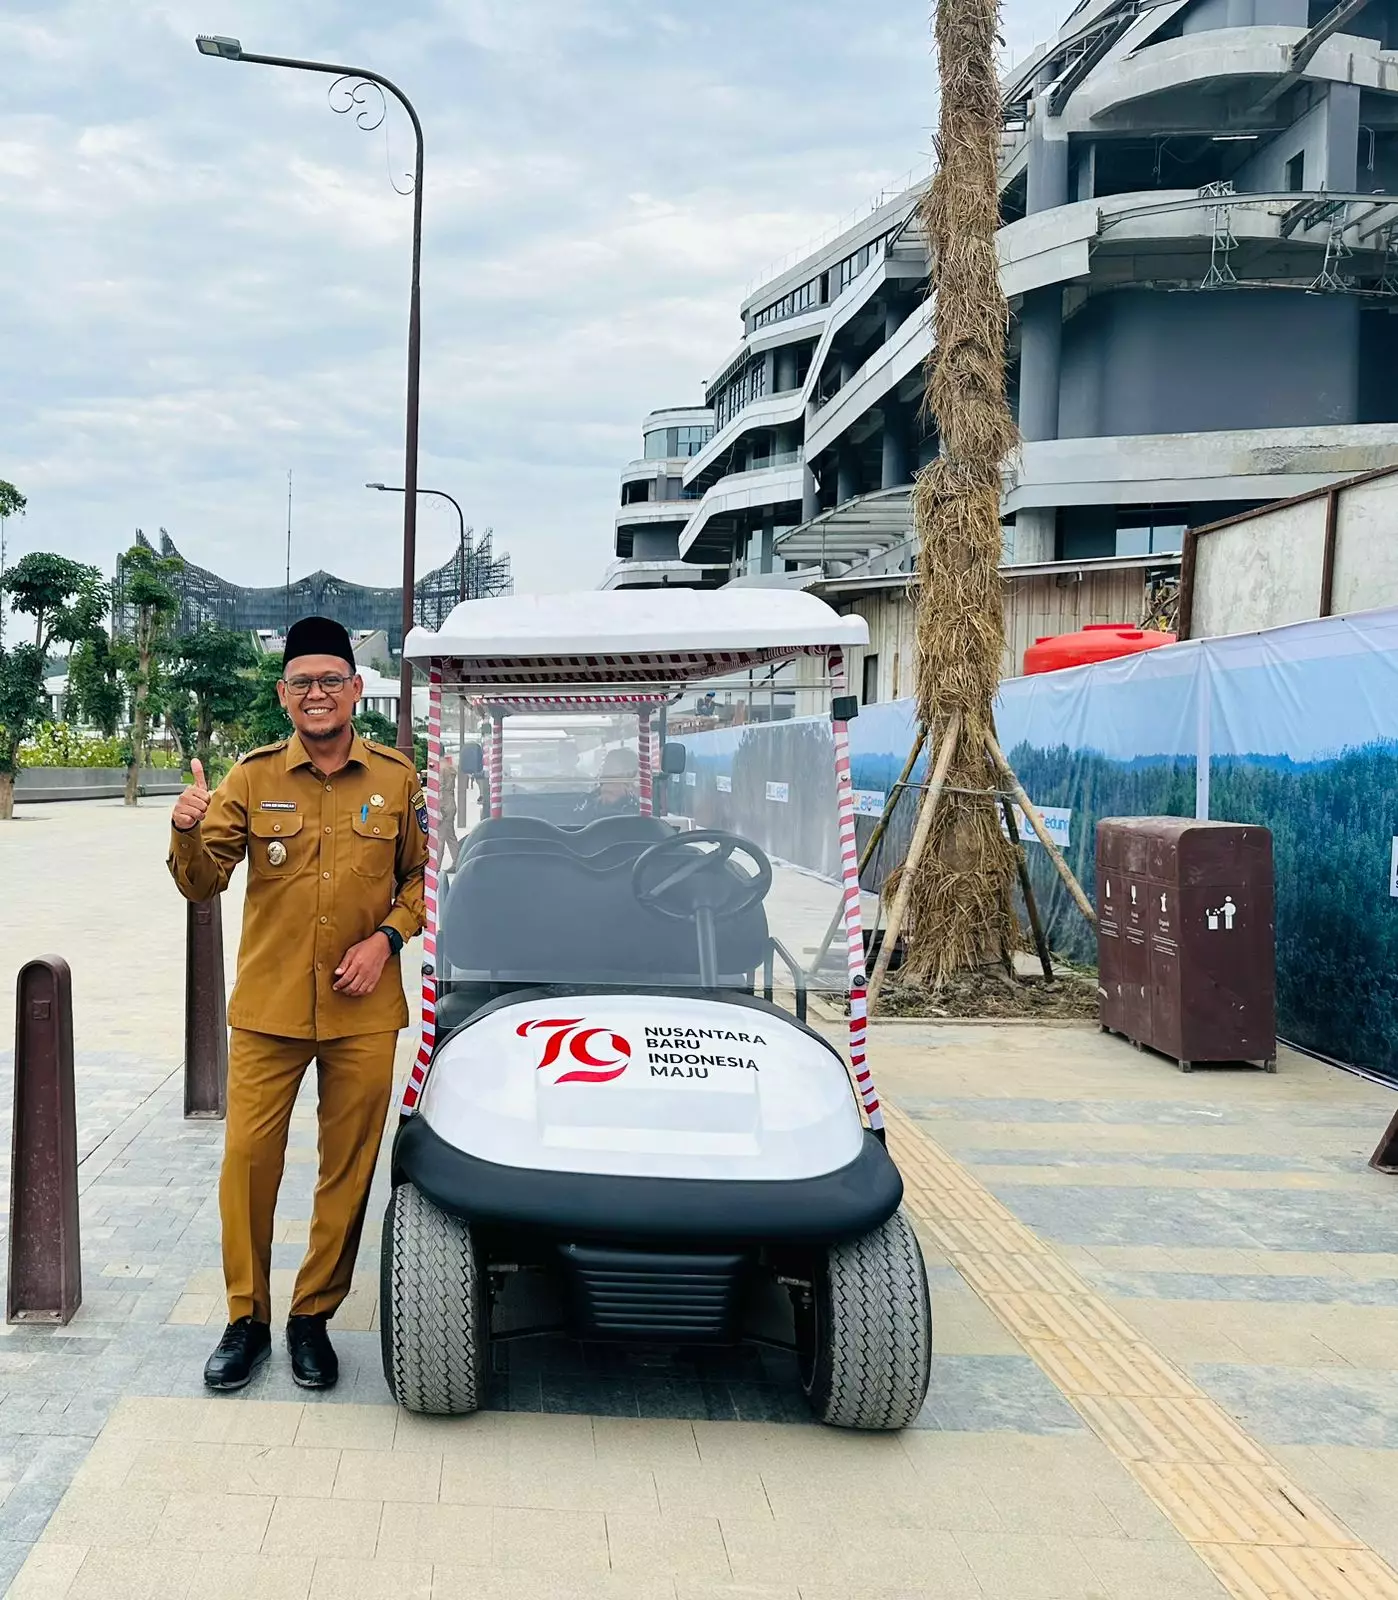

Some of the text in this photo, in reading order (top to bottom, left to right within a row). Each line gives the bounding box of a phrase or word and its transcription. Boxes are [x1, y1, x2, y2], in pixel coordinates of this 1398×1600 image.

[644, 1026, 767, 1046] NUSANTARA
[646, 1038, 701, 1050] BARU
[648, 1053, 759, 1072] INDONESIA
[650, 1065, 709, 1079] MAJU
